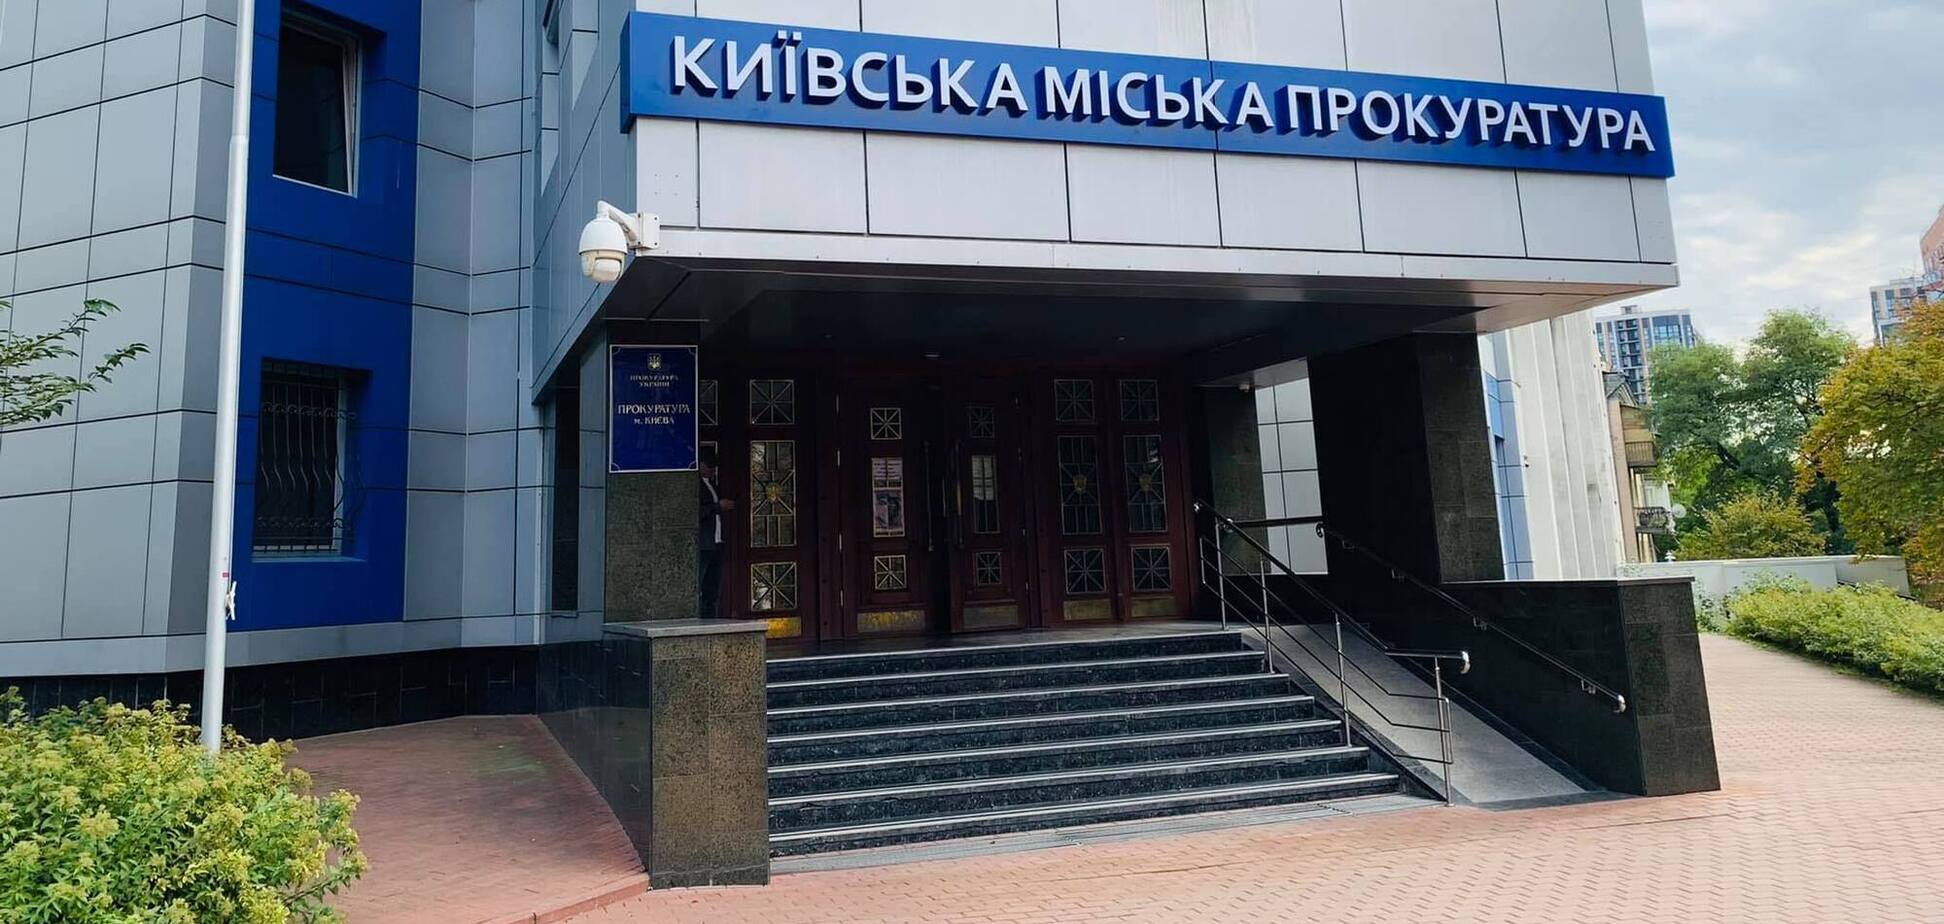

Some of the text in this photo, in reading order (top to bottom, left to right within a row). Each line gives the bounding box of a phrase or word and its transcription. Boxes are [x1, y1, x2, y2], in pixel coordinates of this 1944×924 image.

[672, 30, 1656, 152] КИЇВСЬКА МІСЬКА ПРОКУРАТУРА
[618, 404, 690, 414] ПРОКУРАТУРА
[644, 416, 674, 425] КИЄВА
